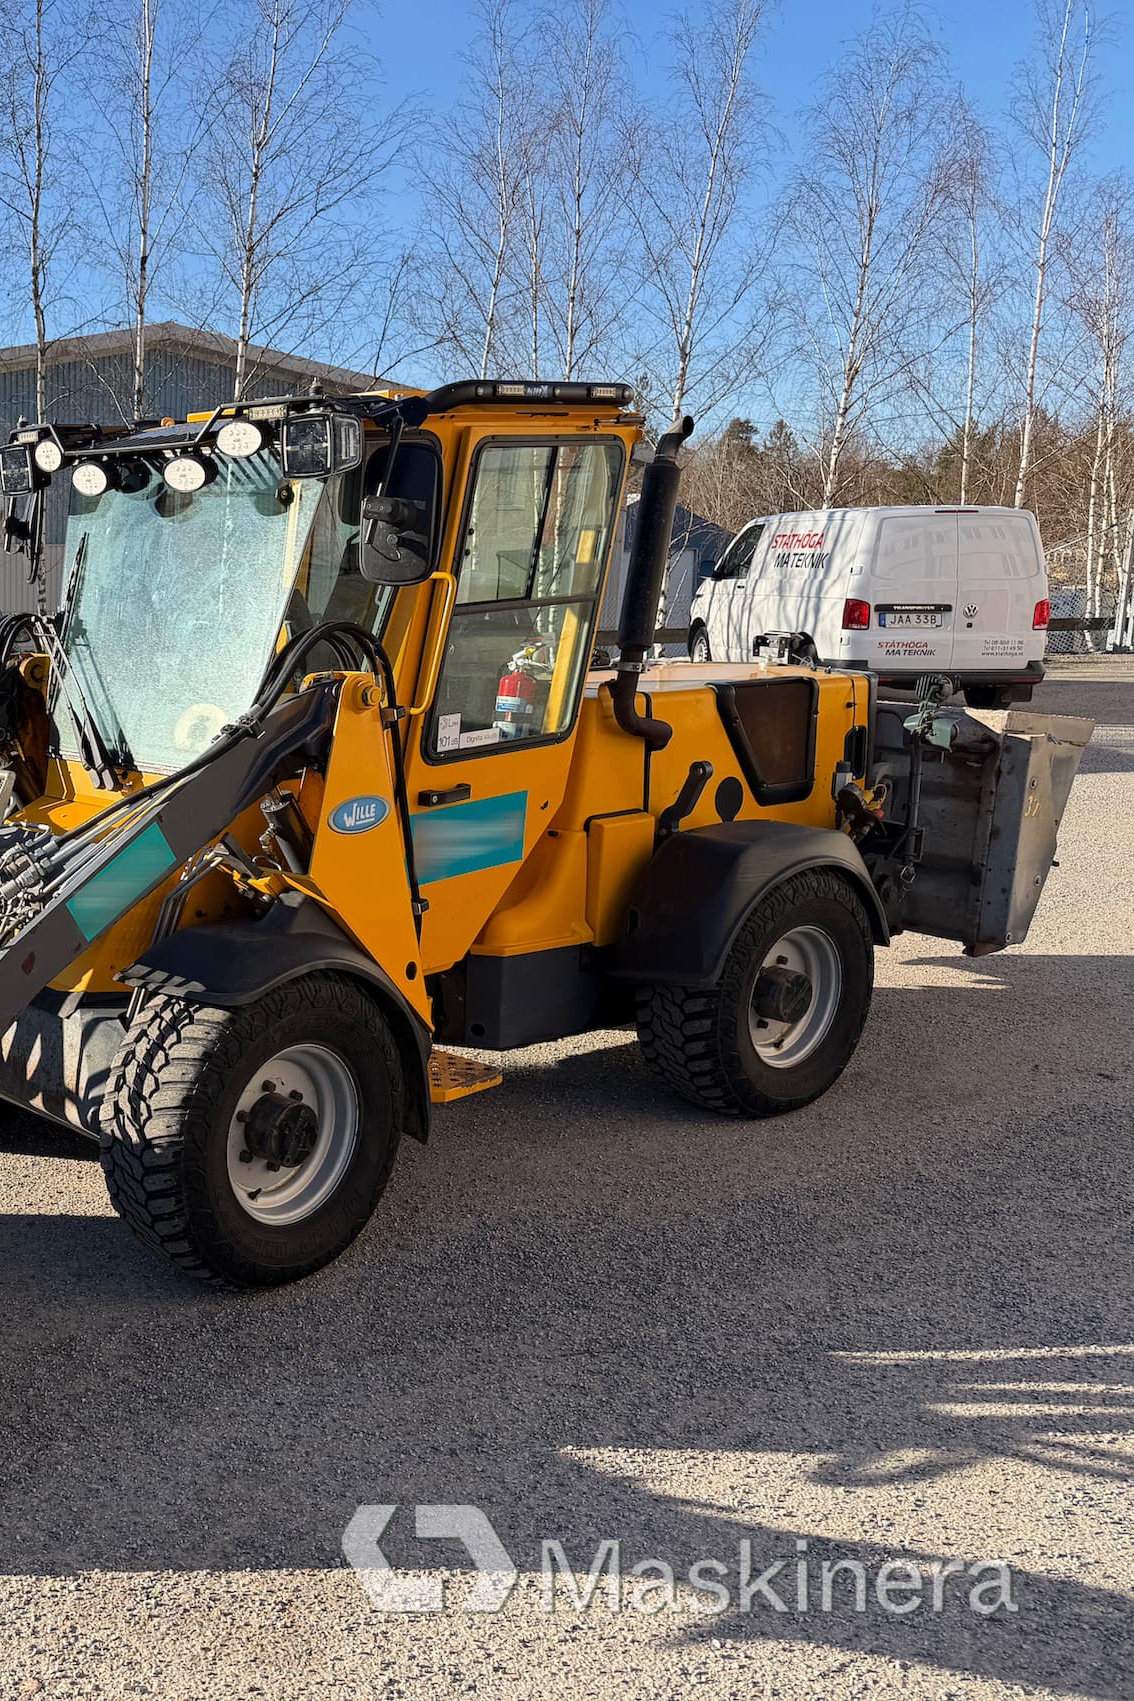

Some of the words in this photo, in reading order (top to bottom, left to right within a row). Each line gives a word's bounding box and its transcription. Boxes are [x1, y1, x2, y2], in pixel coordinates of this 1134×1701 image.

[771, 528, 824, 549] STÅTHÖGA
[774, 552, 791, 568] MA
[791, 552, 829, 568] TEKNIK
[890, 614, 912, 624] JAA
[916, 613, 937, 625] 33B
[877, 640, 928, 649] STÅTHÖGA
